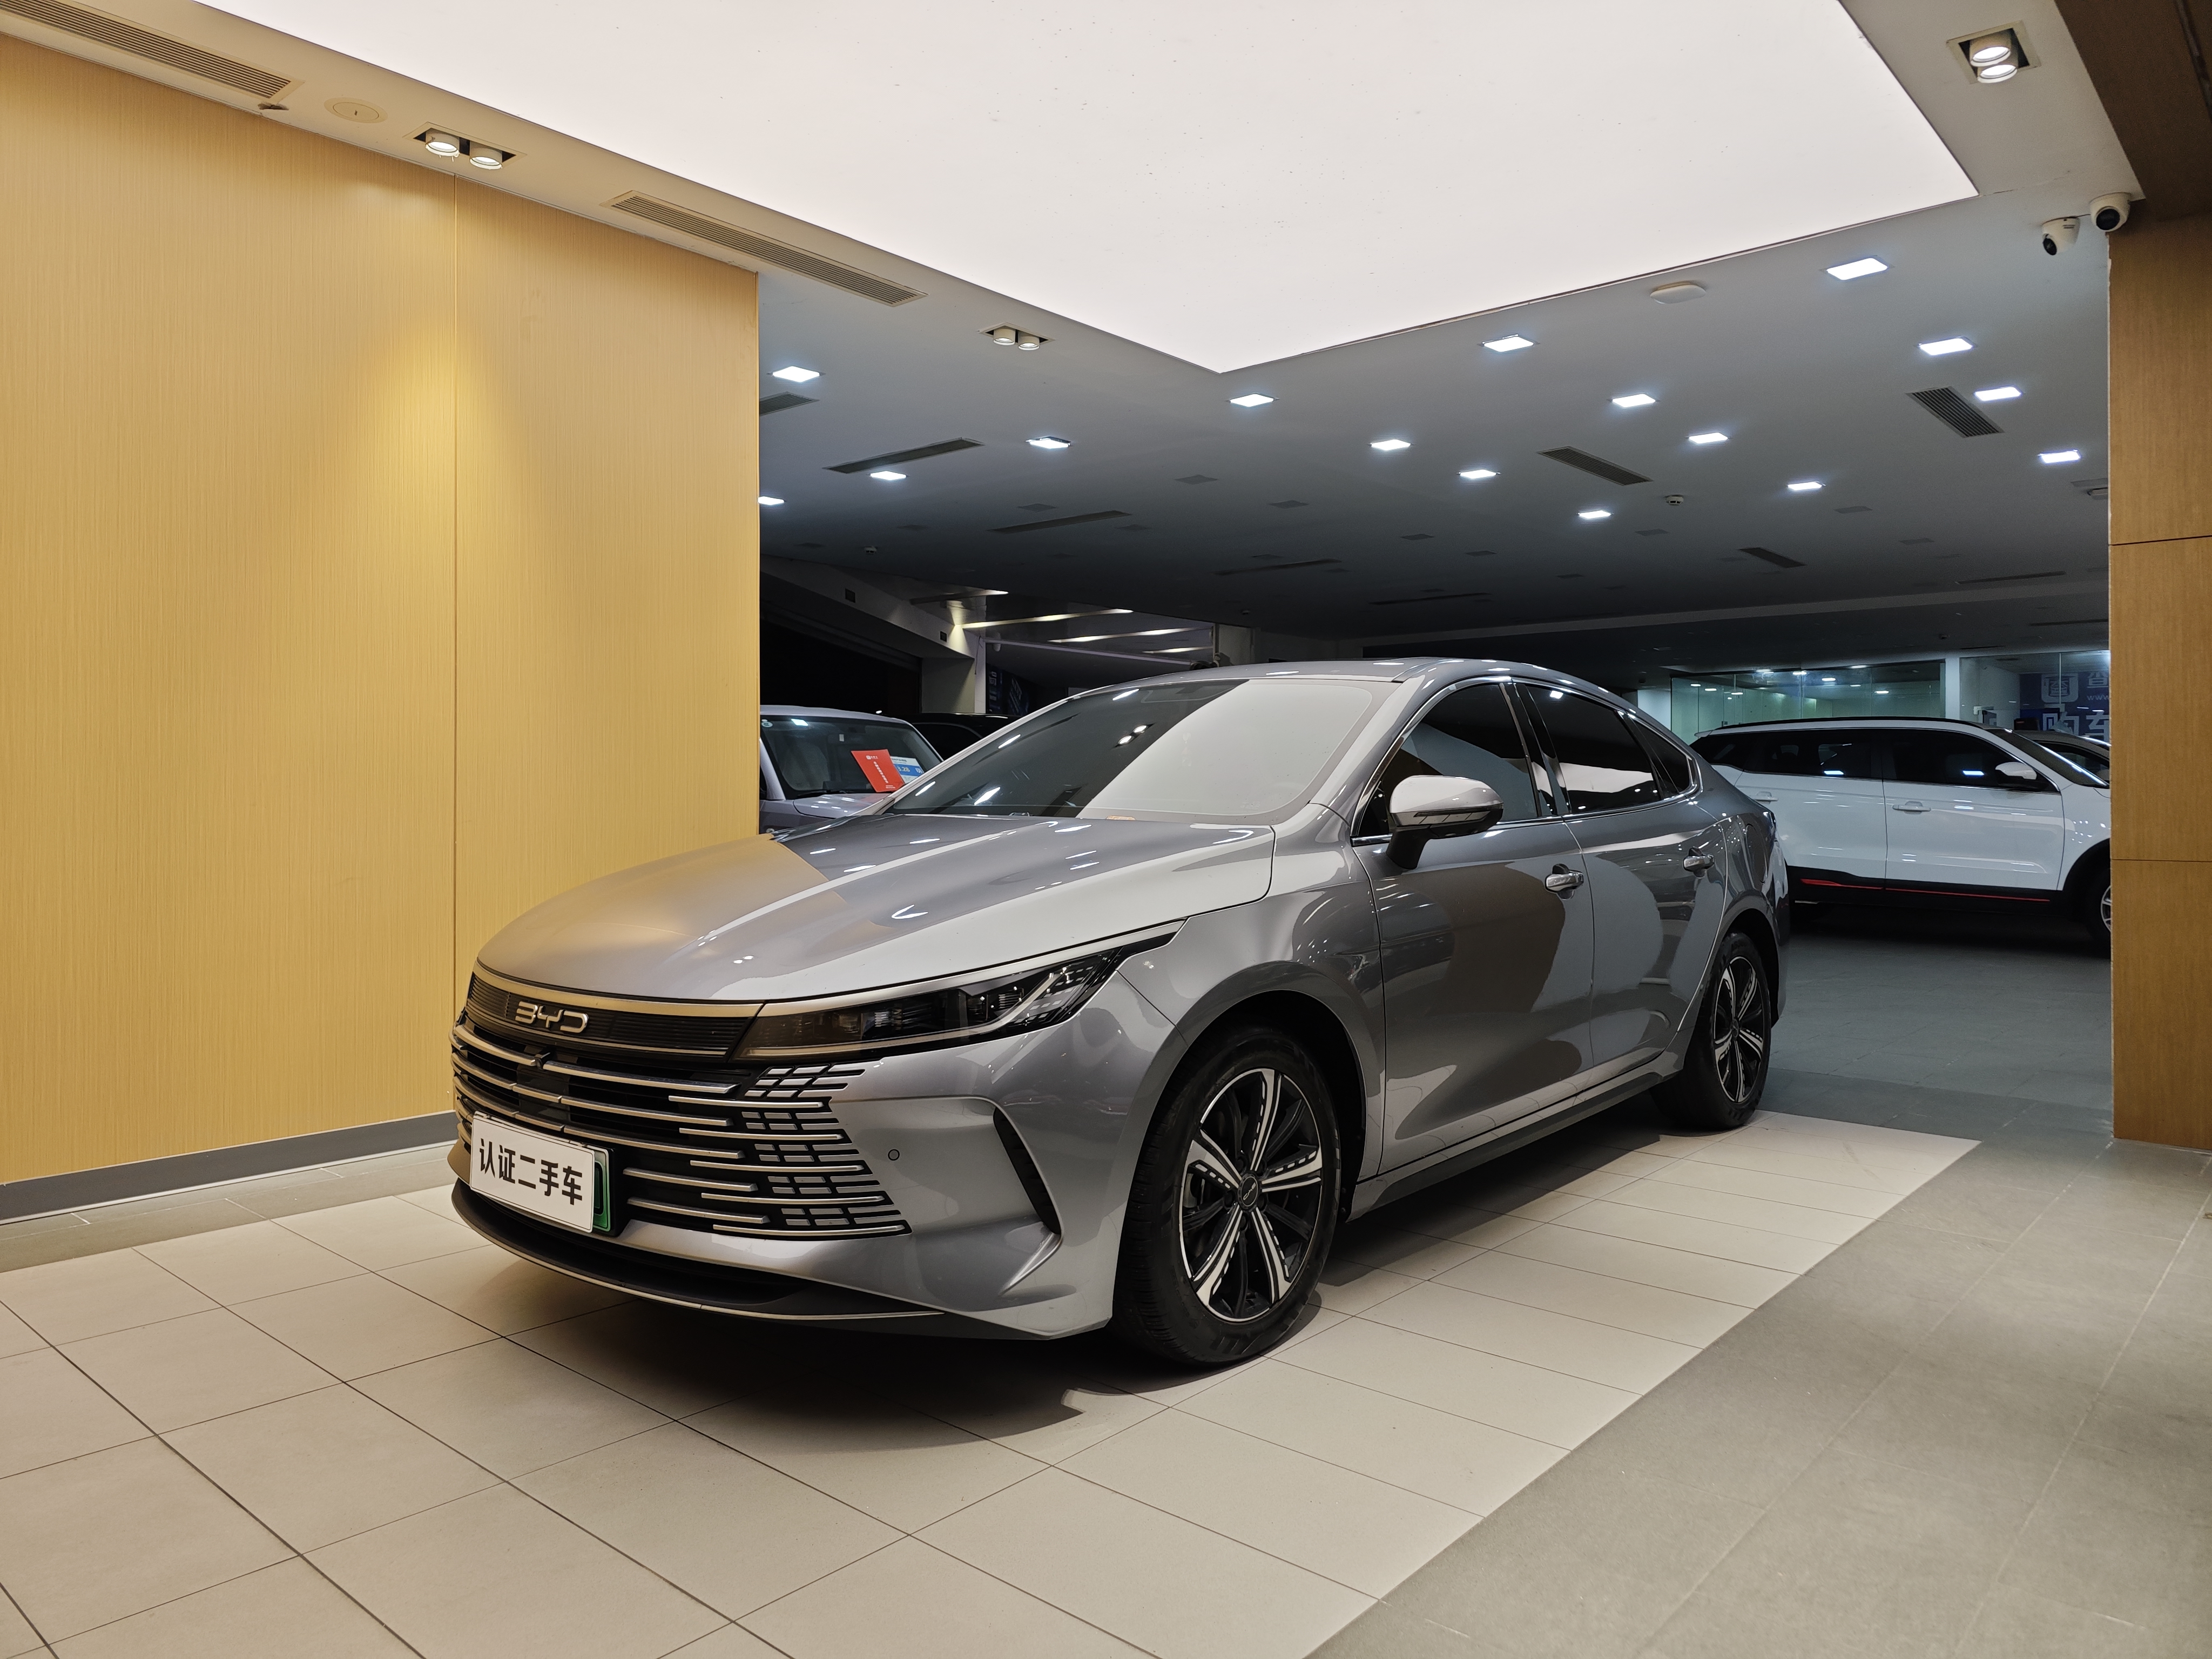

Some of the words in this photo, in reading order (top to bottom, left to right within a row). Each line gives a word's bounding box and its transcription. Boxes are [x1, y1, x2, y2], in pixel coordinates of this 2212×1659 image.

[515, 1001, 589, 1034] BYD
[479, 1138, 583, 1205] 认证二手车
